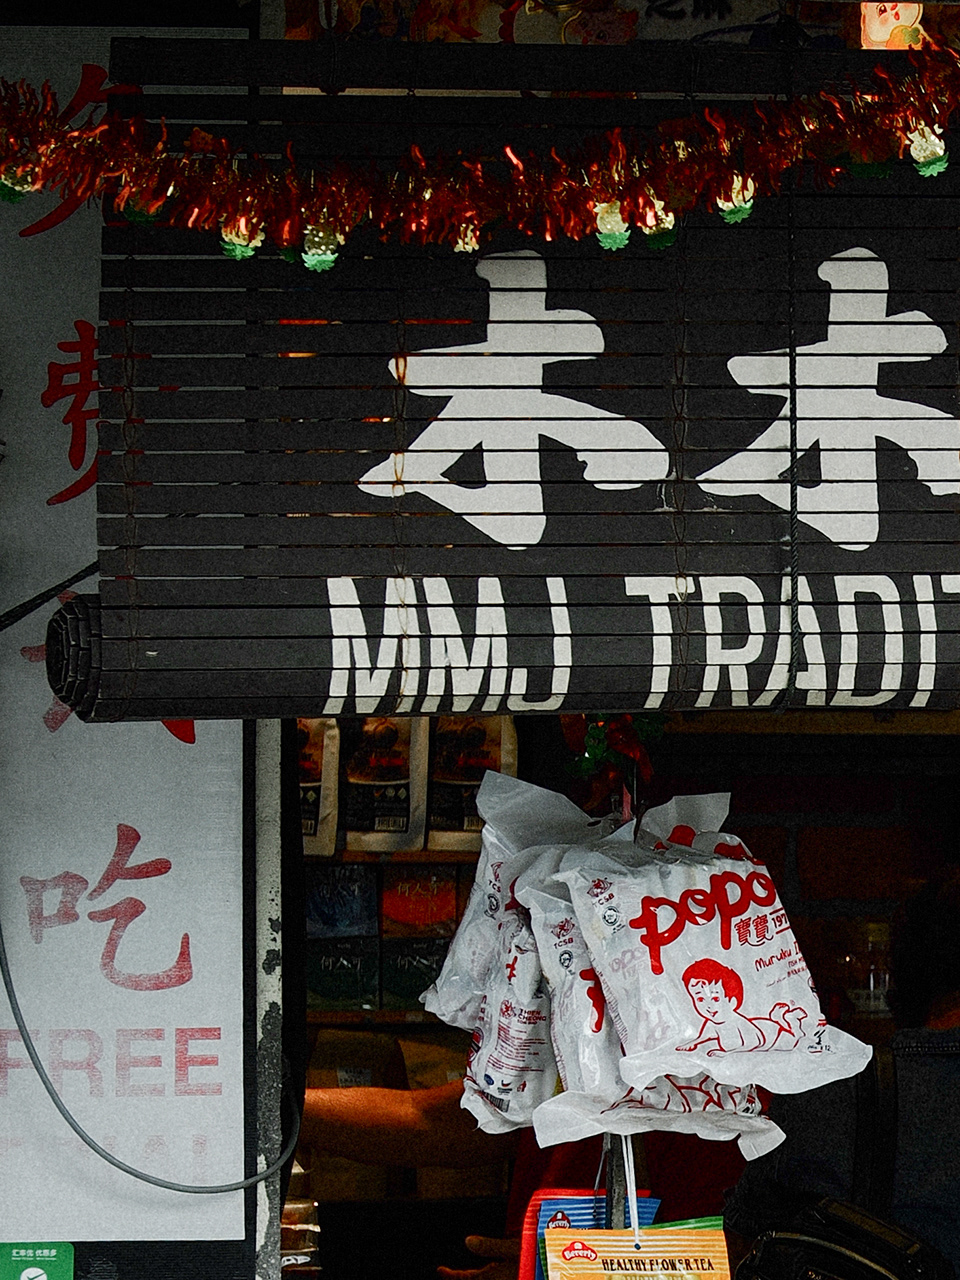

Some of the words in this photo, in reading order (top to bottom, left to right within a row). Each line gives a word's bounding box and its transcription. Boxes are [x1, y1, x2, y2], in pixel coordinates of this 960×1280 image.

[323, 575, 573, 716] MMJ
[628, 871, 776, 976] popo
[0, 1026, 223, 1098] FREE
[601, 1257, 646, 1271] HEALTHY
[649, 1257, 692, 1272] FLOWER
[694, 1258, 715, 1271] TEA
